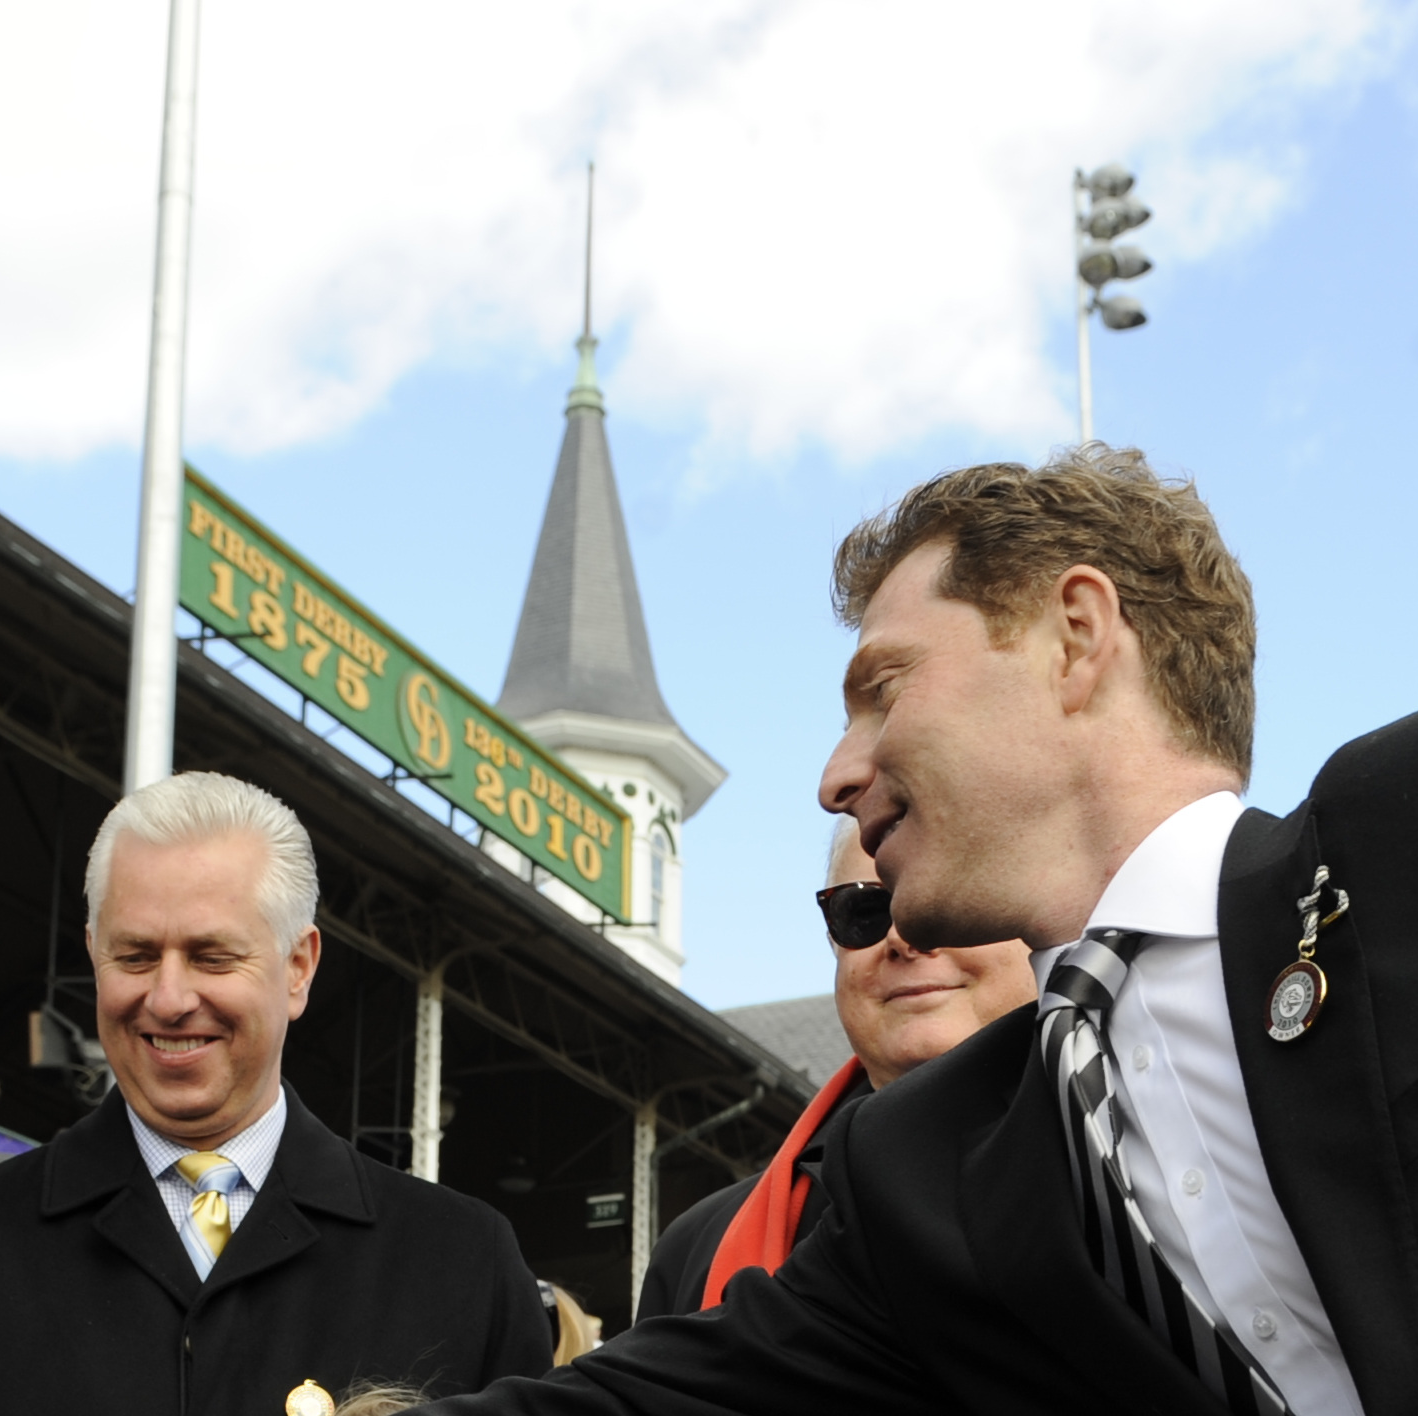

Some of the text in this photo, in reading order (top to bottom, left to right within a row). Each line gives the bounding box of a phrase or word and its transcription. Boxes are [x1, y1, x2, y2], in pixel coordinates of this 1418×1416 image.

[189, 500, 389, 677] FIRST DERBY
[209, 561, 370, 711] 1875
[474, 762, 603, 882] 2010
[529, 765, 614, 848] DERBY
[1277, 1016, 1299, 1029] 2010
